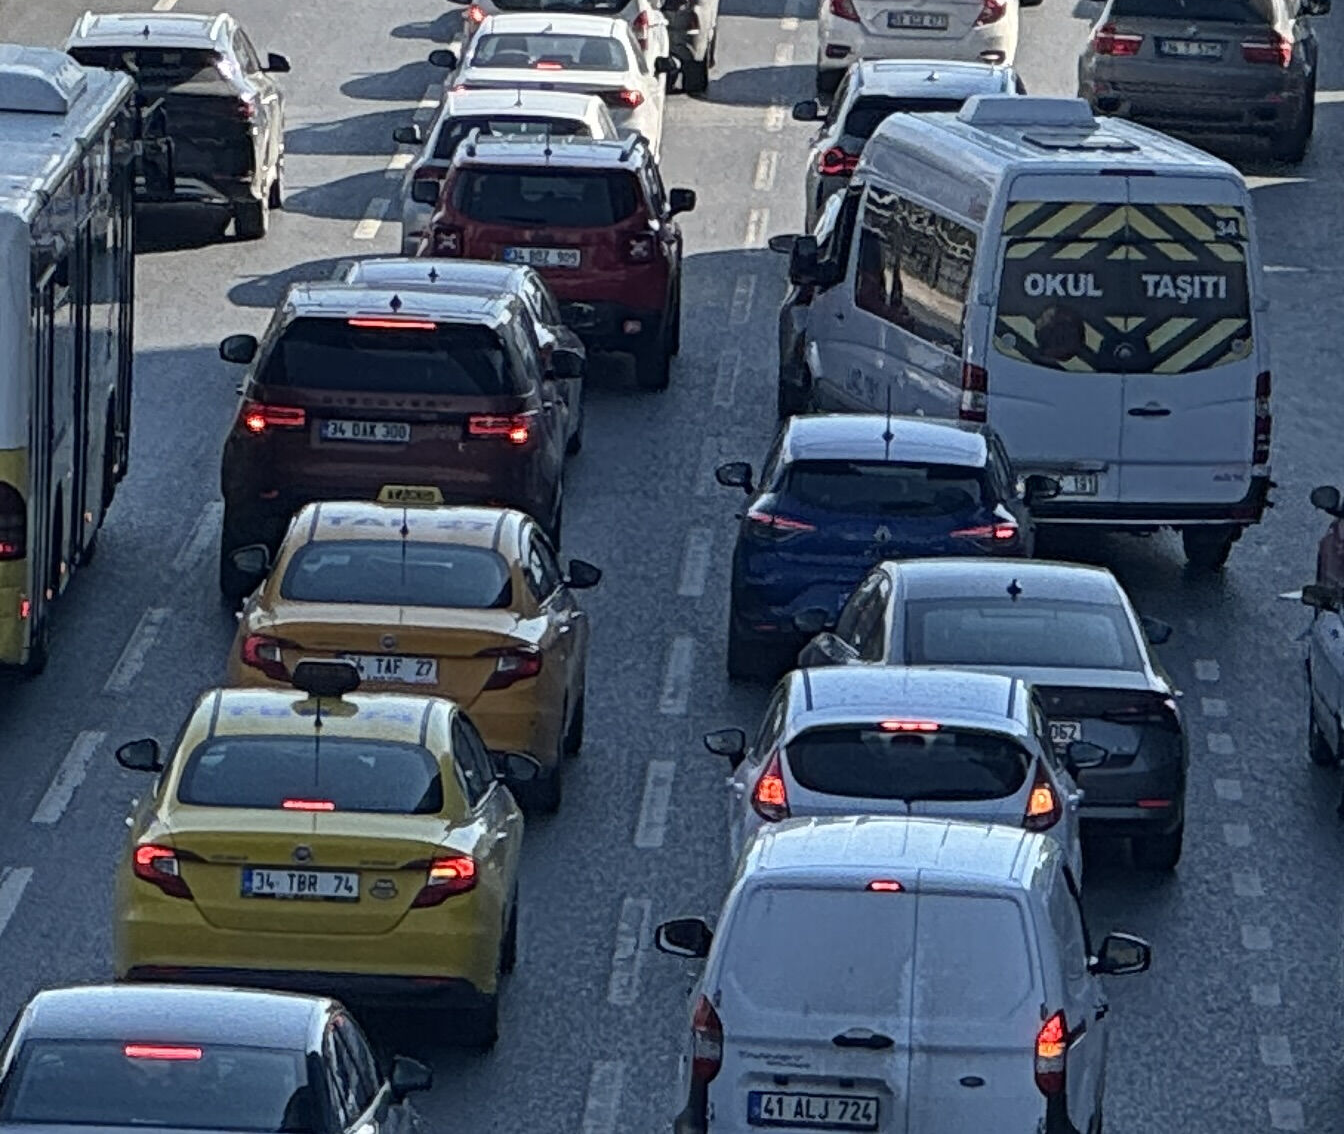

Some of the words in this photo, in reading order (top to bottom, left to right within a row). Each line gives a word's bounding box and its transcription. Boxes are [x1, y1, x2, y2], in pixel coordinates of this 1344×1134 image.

[1216, 221, 1237, 236] 34
[1024, 273, 1103, 297] OKUL
[1142, 275, 1227, 304] TAŞITI
[330, 422, 346, 436] 34
[382, 425, 406, 439] 300
[376, 658, 402, 674] TAF
[416, 661, 433, 676] 27
[255, 873, 275, 890] 34
[288, 874, 317, 892] TBR
[333, 876, 353, 893] 74
[764, 1097, 783, 1116] 41
[794, 1098, 829, 1119] ALJ
[839, 1101, 872, 1121] 724
